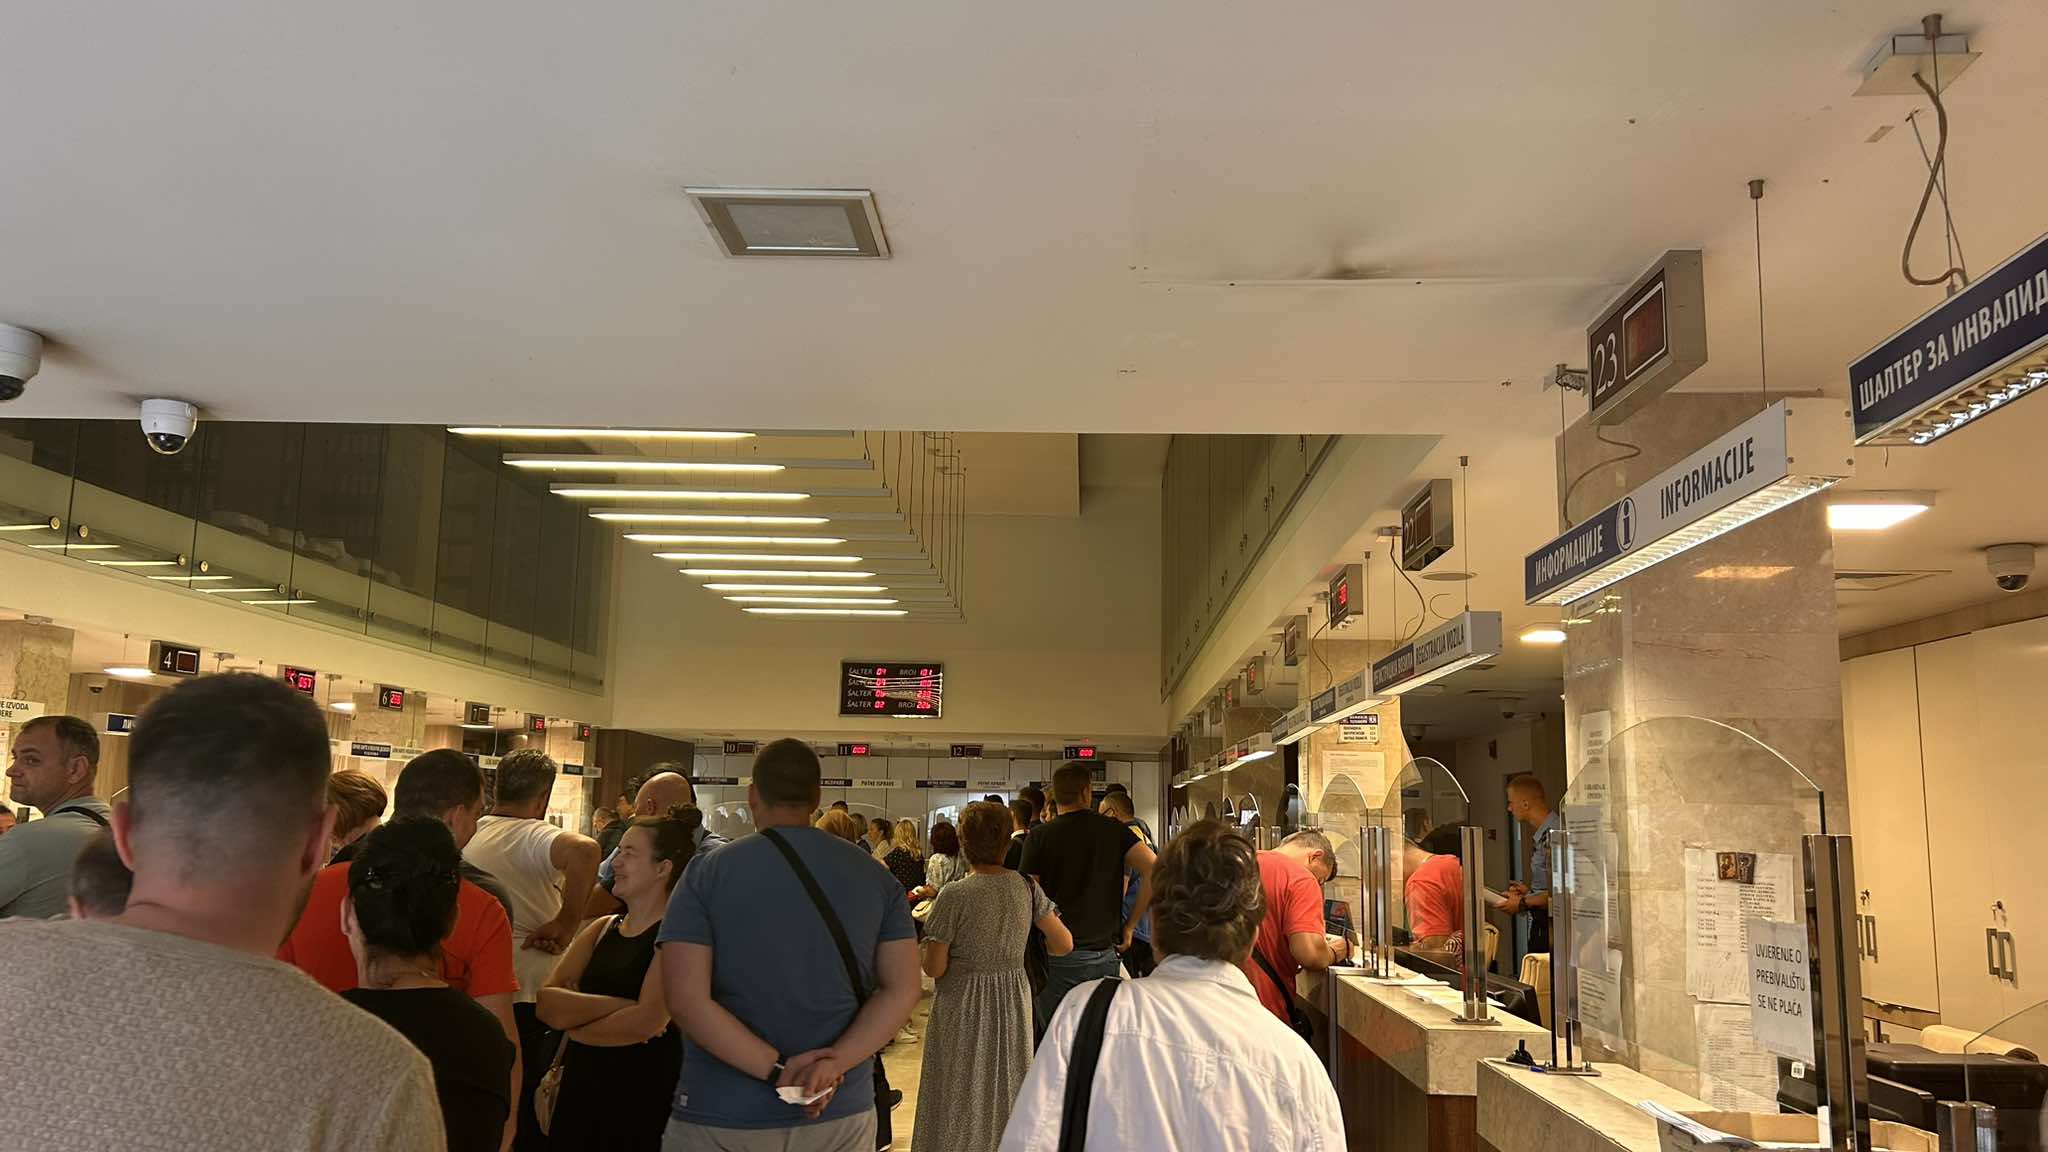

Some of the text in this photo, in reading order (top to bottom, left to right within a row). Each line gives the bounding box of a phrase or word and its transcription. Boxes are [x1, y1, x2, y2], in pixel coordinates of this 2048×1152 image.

[1594, 332, 1617, 397] 23
[1859, 349, 1923, 411] ШАЛТЕР
[1926, 334, 1949, 371] ЗА
[1660, 437, 1754, 519] INFORMACIJE
[1404, 517, 1415, 554] 22
[1535, 524, 1603, 586] ИНФОРМАЦИЈЕ
[1415, 624, 1464, 665] REGISTRACIJA VOZILA
[163, 651, 171, 668] 4
[6, 702, 29, 710] IZVODA
[382, 691, 388, 705] 6
[726, 744, 736, 753] 10
[840, 746, 848, 754] 11
[953, 747, 962, 756] 12
[1066, 748, 1076, 757] 13
[1755, 943, 1802, 963] UVJERENJE O
[1756, 969, 1805, 991] PREBIVALIŠTU
[1757, 994, 1766, 1009] SE
[1768, 996, 1778, 1012] NE
